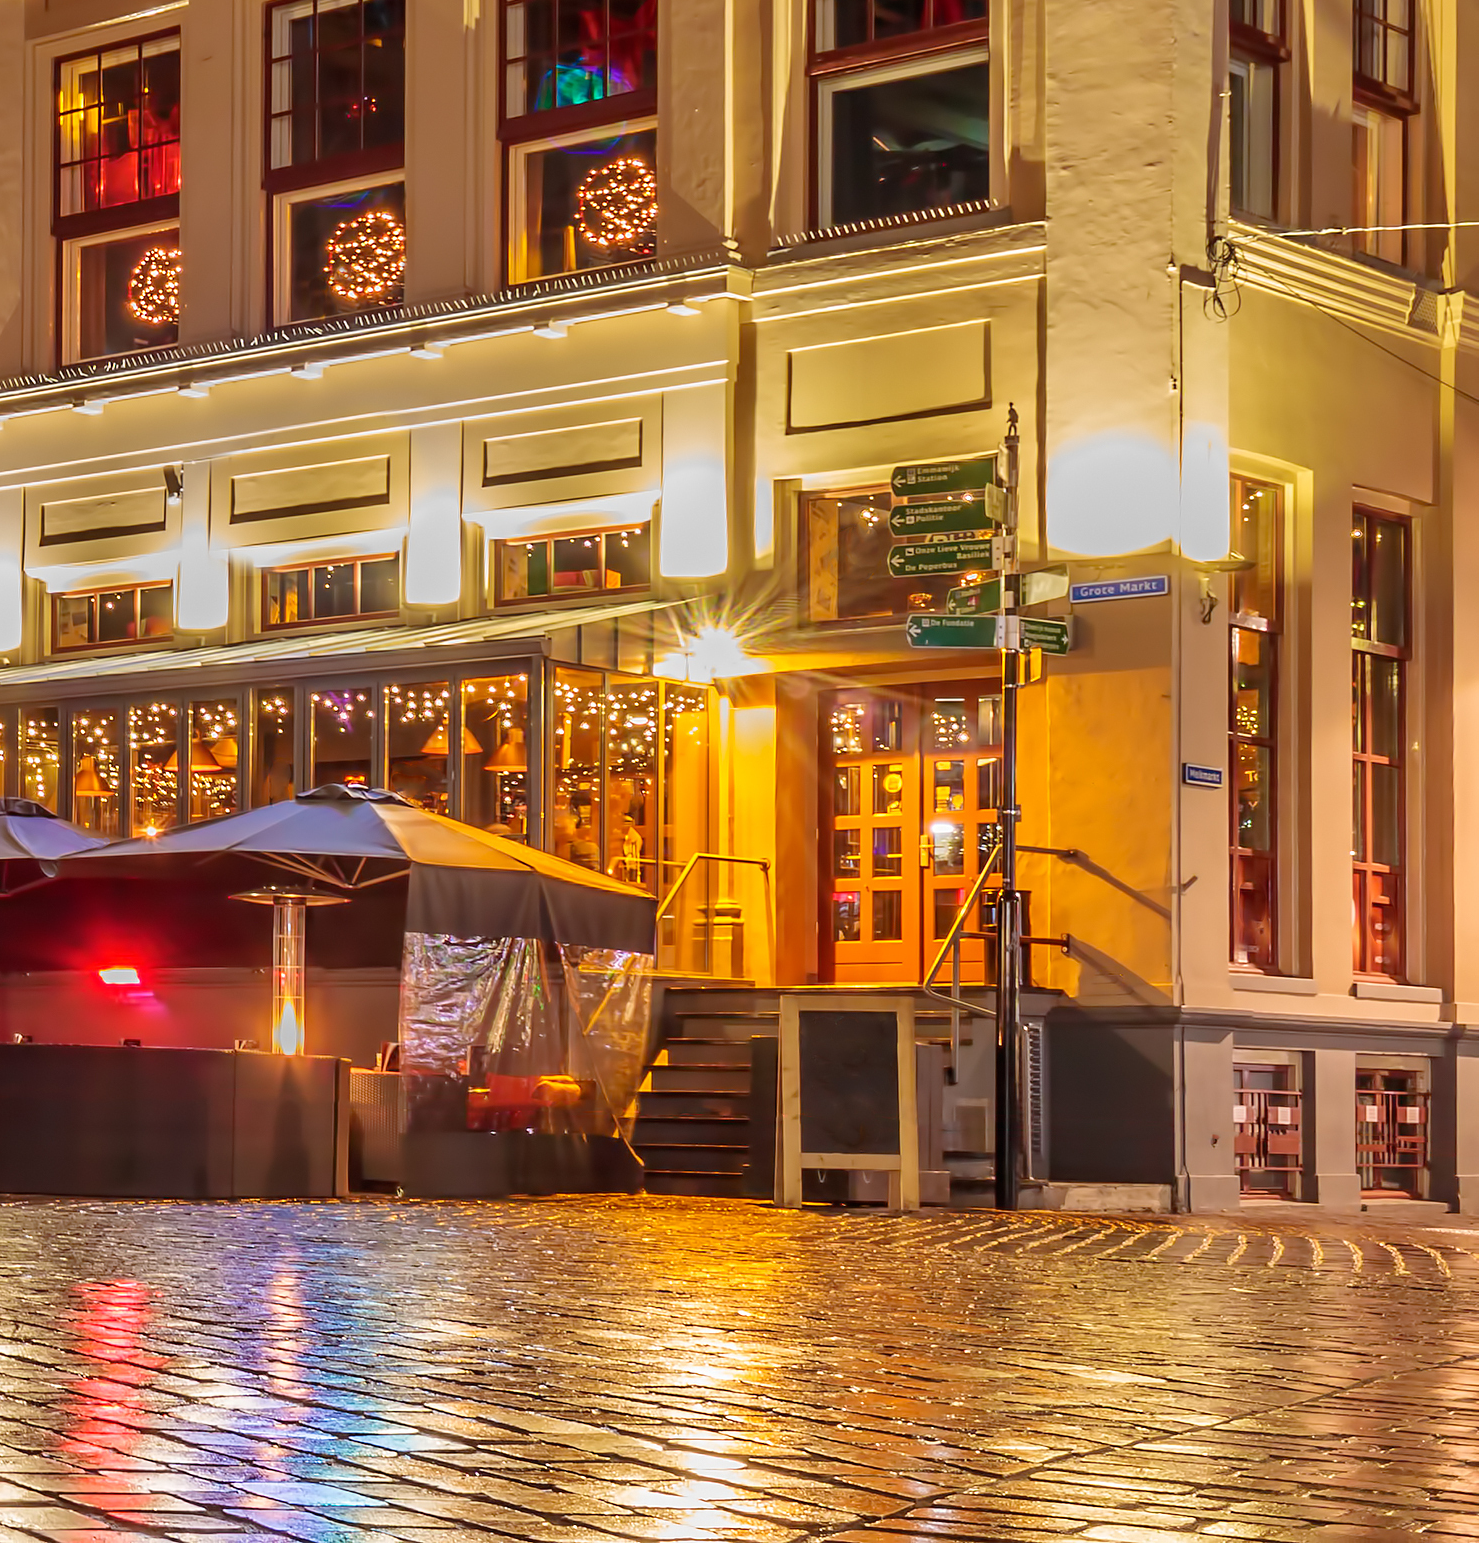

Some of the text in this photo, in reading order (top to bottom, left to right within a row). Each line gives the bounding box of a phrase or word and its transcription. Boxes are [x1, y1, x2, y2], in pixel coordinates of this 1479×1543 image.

[918, 474, 948, 483] Station
[906, 505, 962, 515] Stadskantoor
[916, 515, 944, 523] Politie
[915, 542, 991, 555] Onze Lieve Vrouwe
[905, 561, 958, 572] De Peperbus
[1080, 580, 1158, 597] Grote Markt
[930, 618, 941, 627] De
